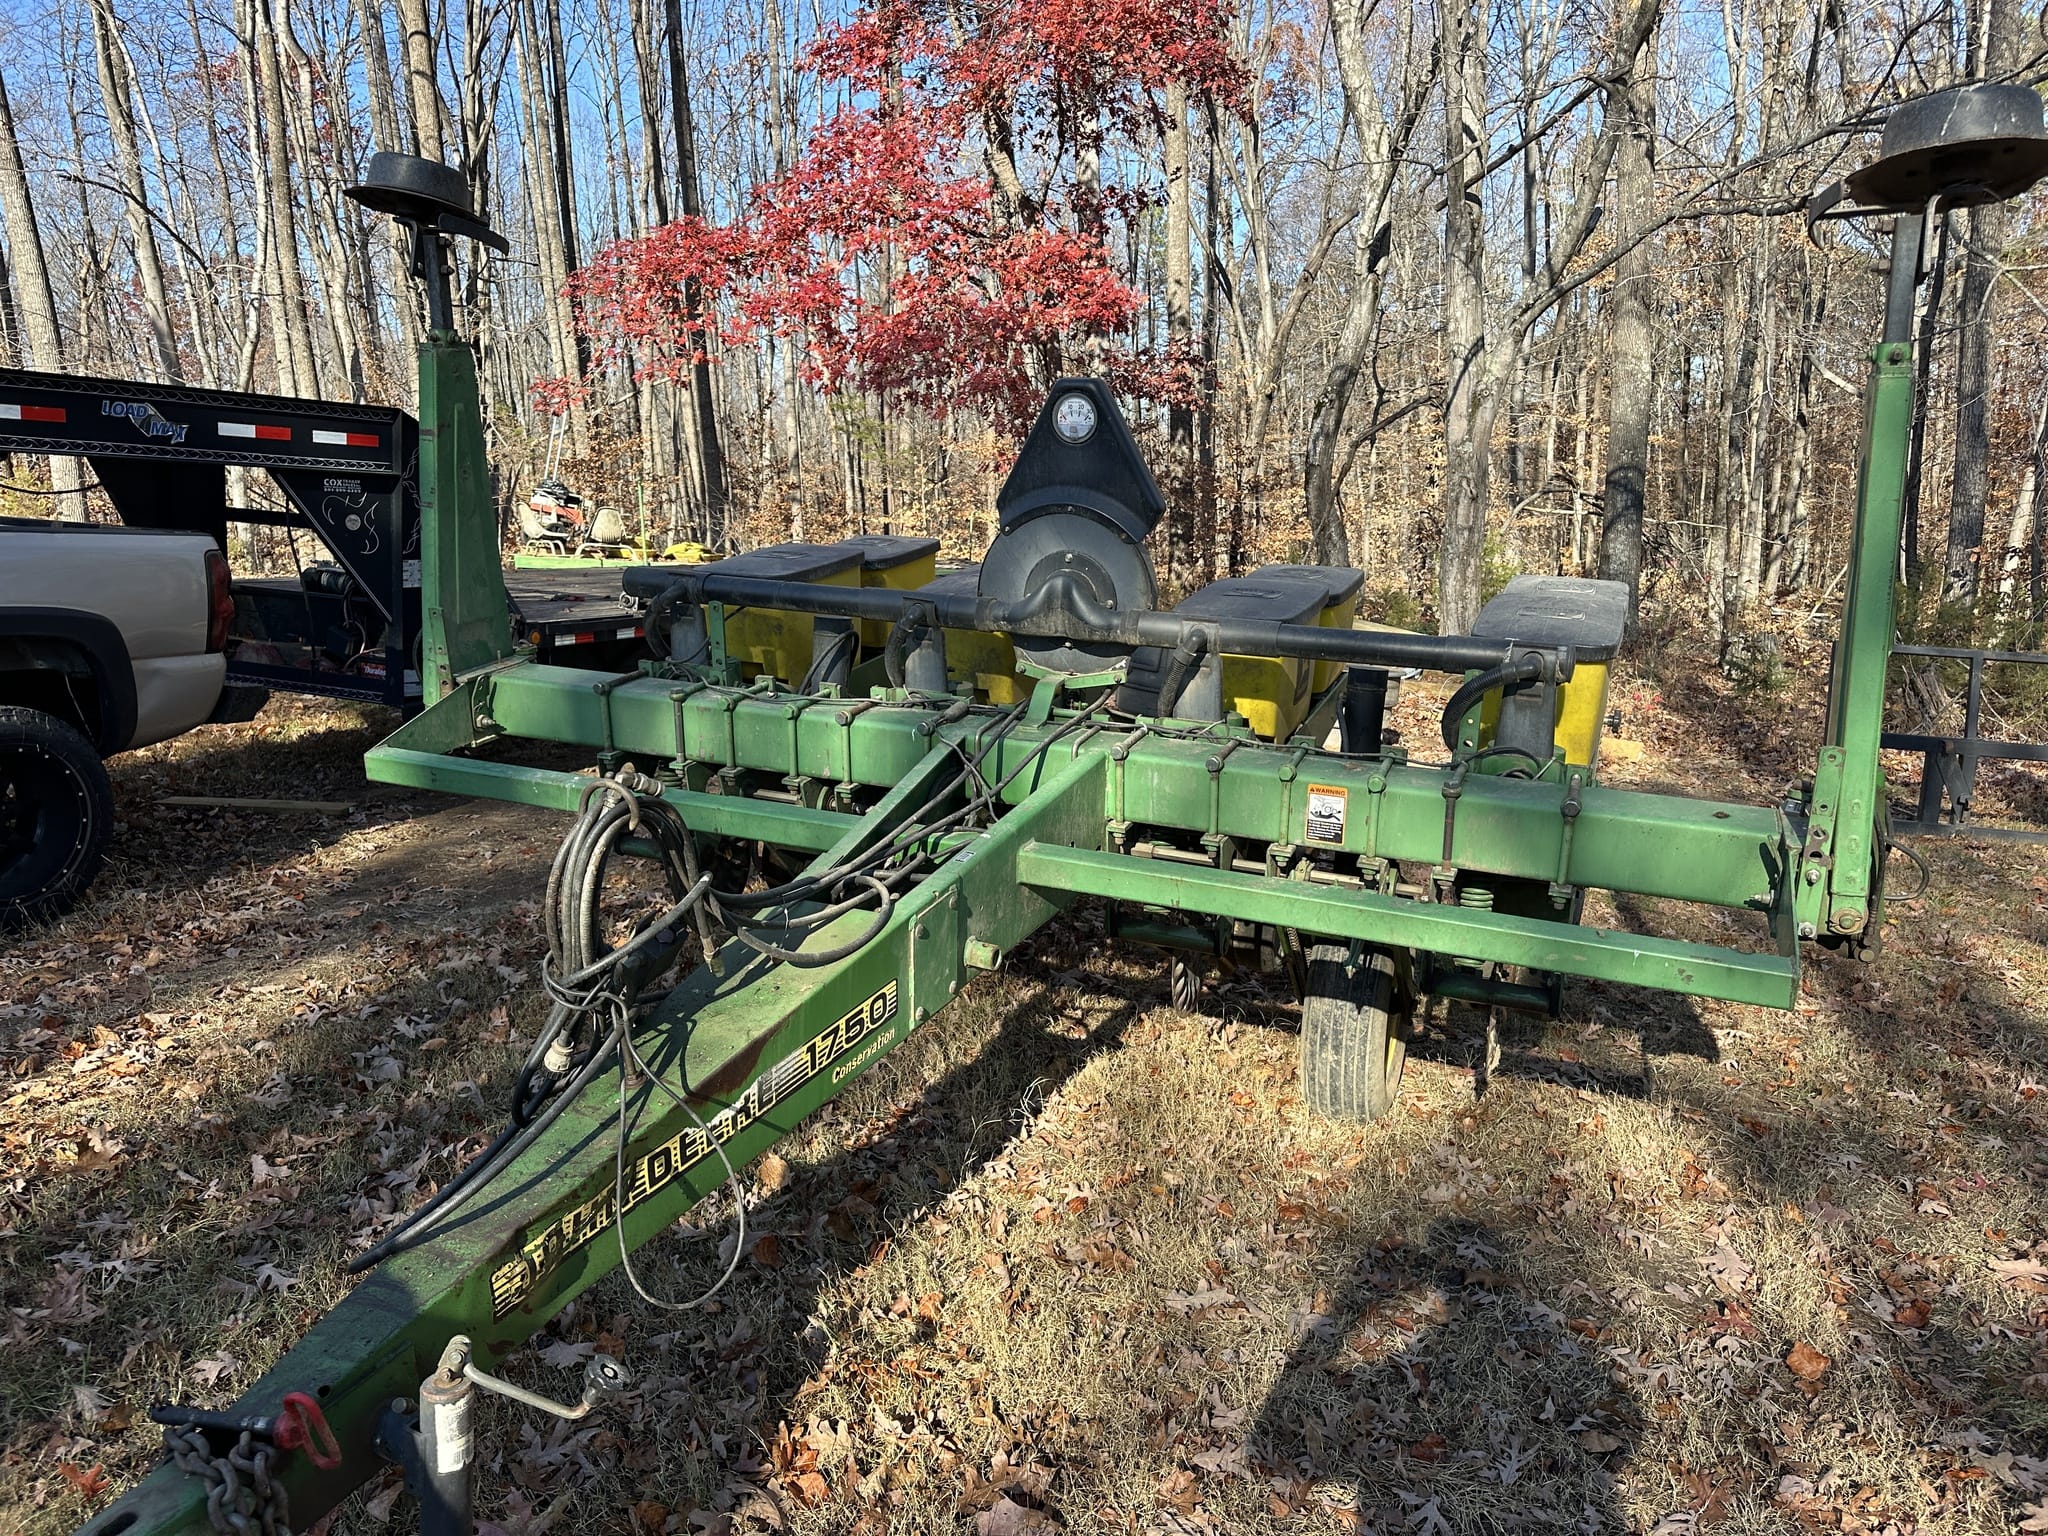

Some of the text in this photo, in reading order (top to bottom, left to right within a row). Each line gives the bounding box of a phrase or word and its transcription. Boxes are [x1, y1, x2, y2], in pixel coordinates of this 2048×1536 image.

[102, 400, 149, 418] LOAD
[150, 420, 189, 444] MAX
[323, 478, 342, 486] COX
[1315, 787, 1346, 796] WARNING
[803, 988, 889, 1077] 1750
[832, 1027, 895, 1084] Conservation
